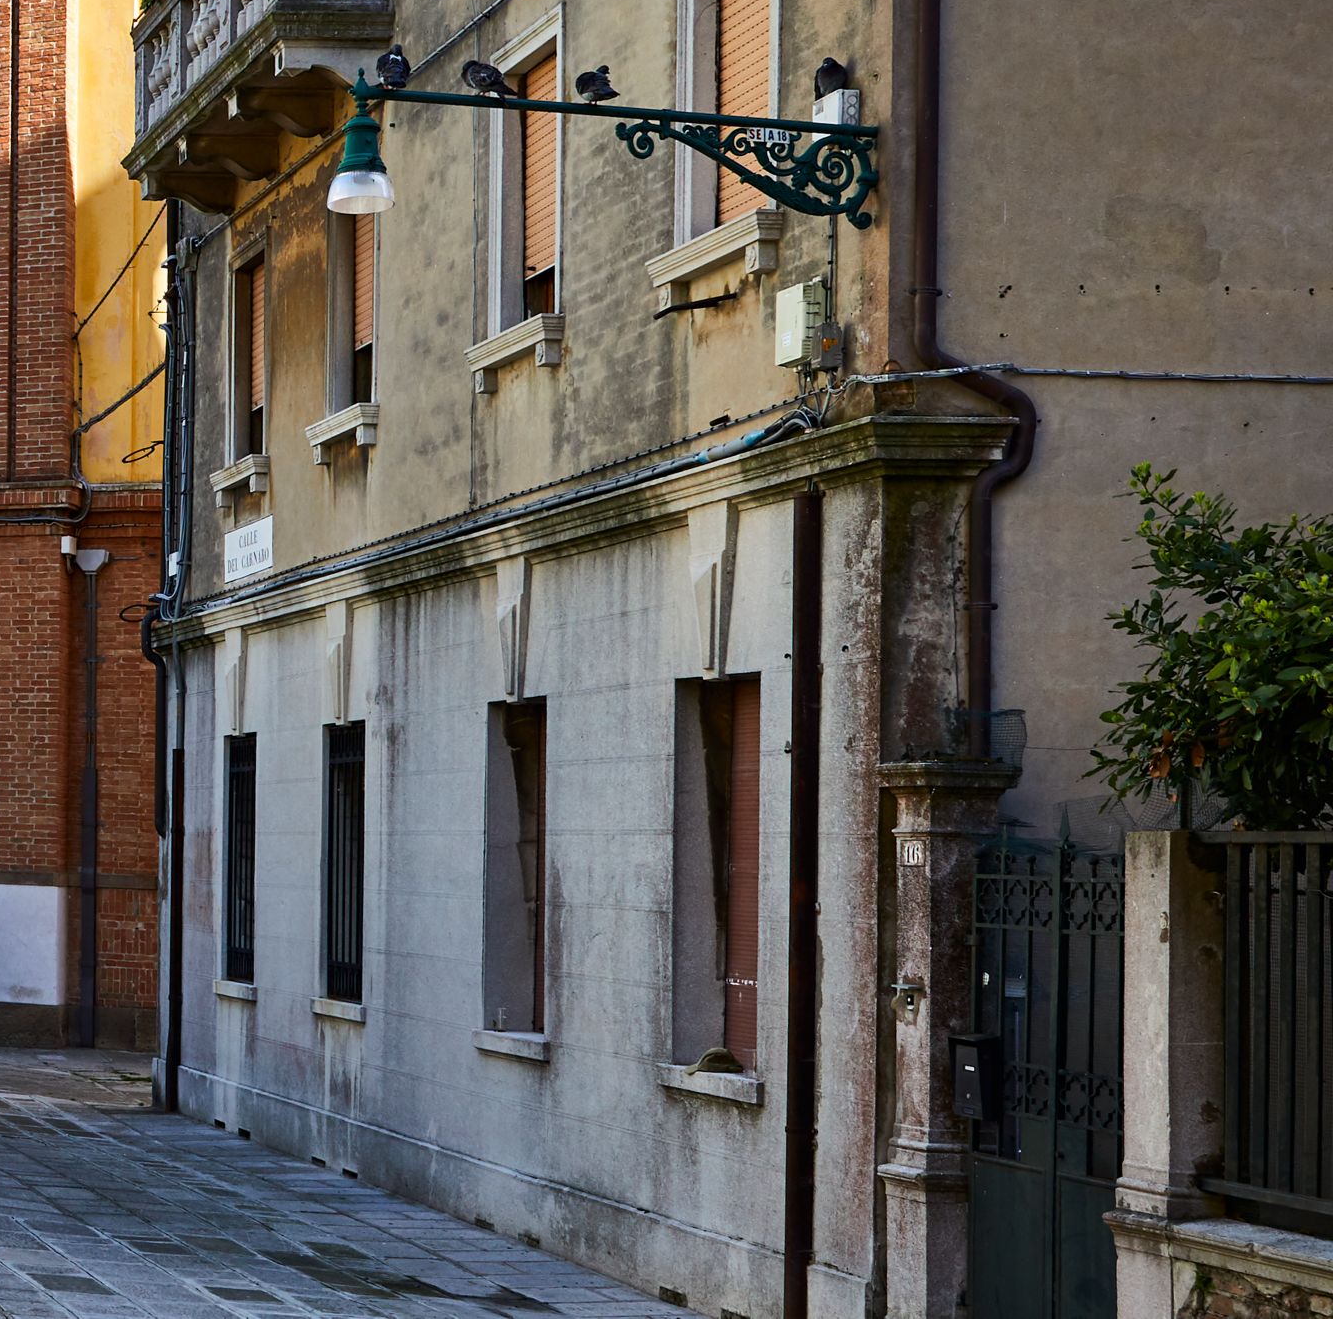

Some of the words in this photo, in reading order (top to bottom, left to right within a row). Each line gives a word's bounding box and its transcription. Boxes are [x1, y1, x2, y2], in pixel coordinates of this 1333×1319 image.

[749, 129, 762, 140] SE
[768, 130, 775, 141] A
[778, 131, 787, 141] 18
[239, 530, 258, 548] CALLE
[228, 559, 238, 573] DEL
